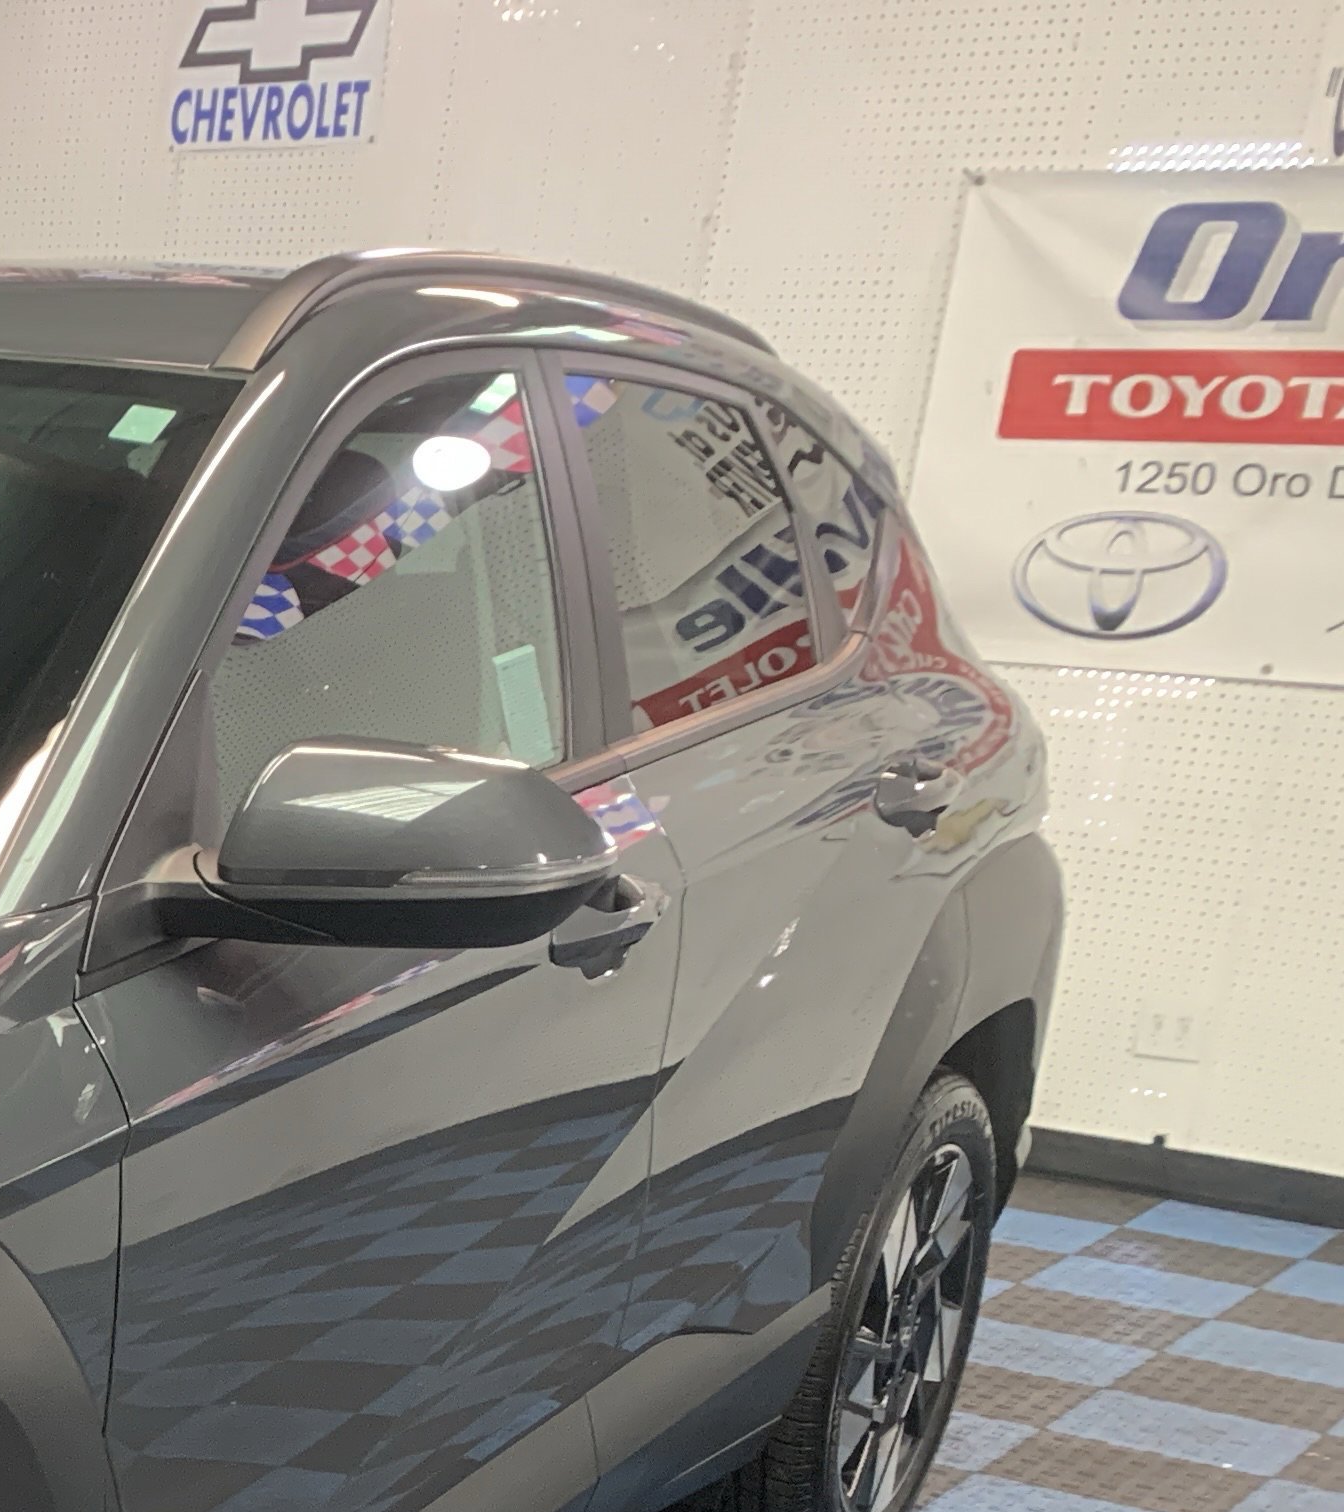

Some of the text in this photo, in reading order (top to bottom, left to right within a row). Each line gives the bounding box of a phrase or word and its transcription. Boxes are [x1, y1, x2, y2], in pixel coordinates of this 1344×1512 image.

[171, 80, 371, 144] CHEVROLET
[1052, 374, 1344, 420] TOYOT
[1113, 460, 1217, 496] 1250
[1233, 462, 1311, 499] Oro
